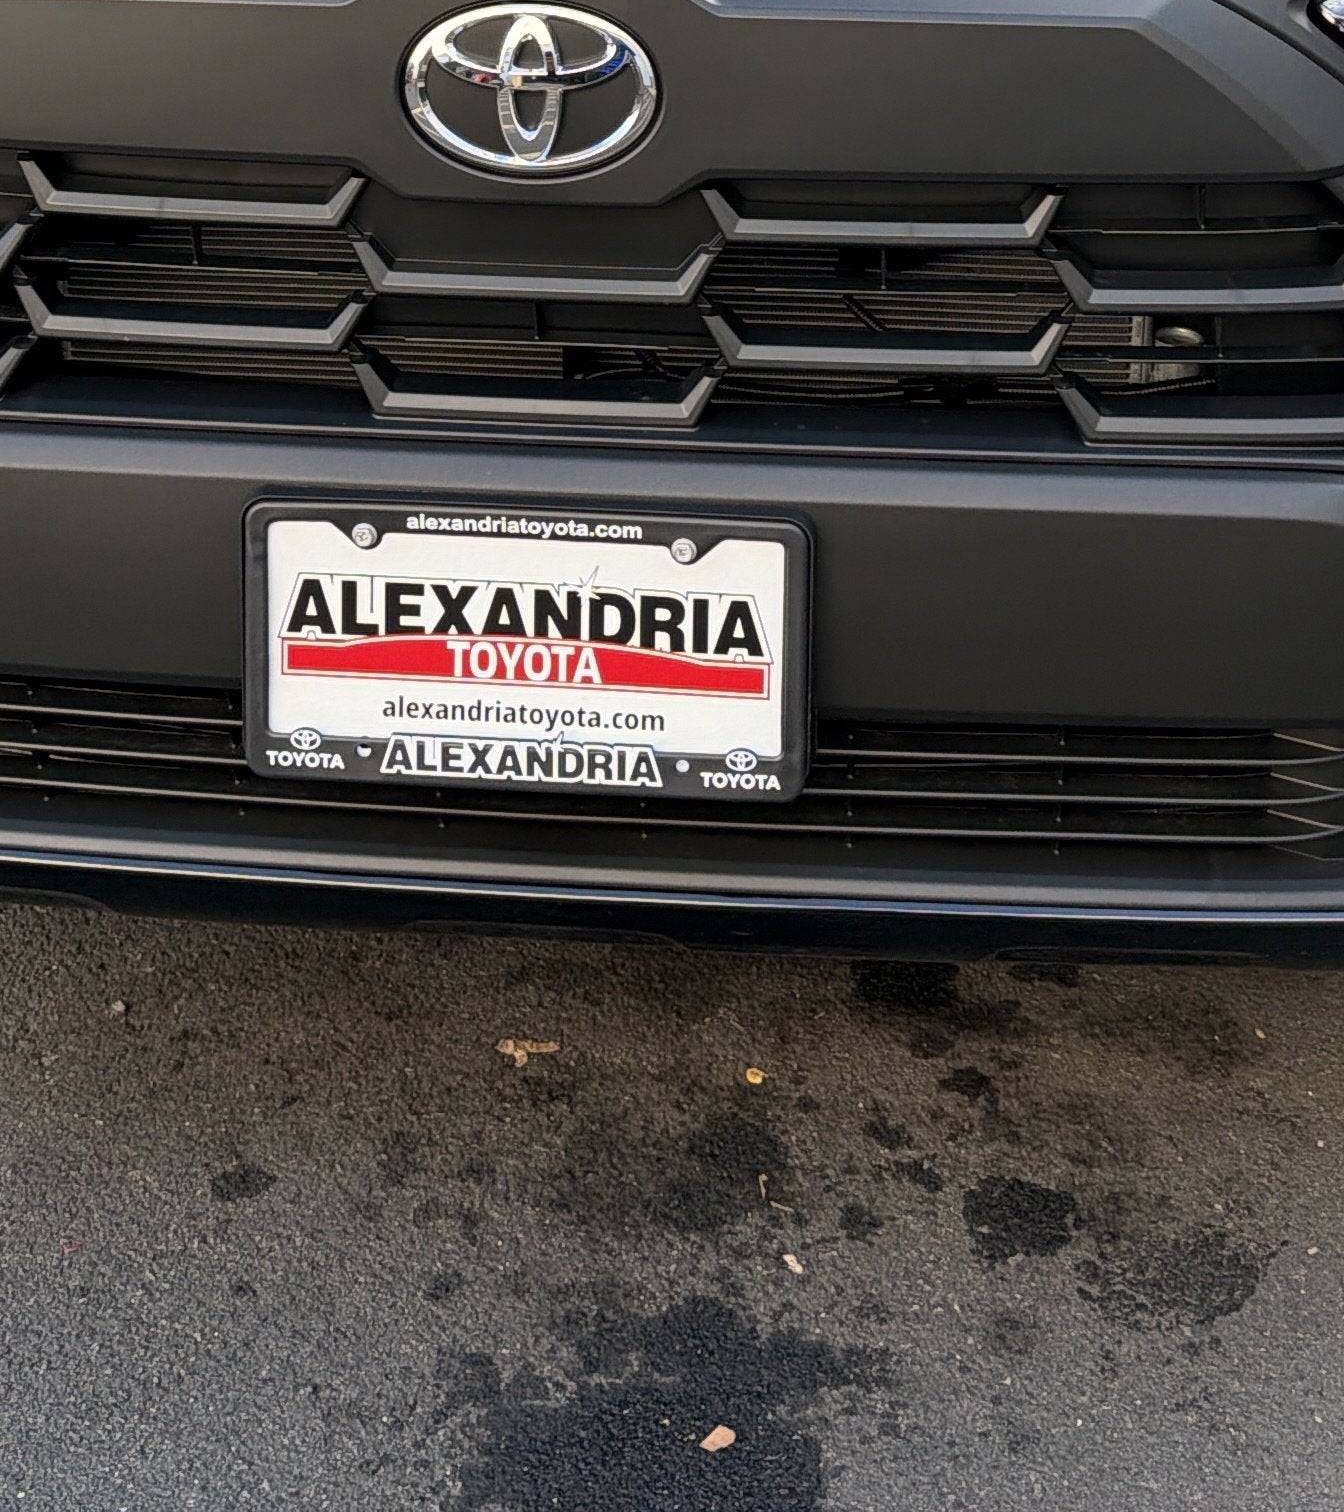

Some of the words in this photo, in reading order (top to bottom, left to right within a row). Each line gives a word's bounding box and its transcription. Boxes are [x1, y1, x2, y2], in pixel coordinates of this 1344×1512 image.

[406, 513, 643, 540] alexandriatoyota.com
[287, 578, 765, 657] ALEXANDRIA
[447, 642, 603, 684] TOYOTA
[382, 696, 666, 732] alexandriatoyota.com
[266, 750, 346, 771] TOYOTA
[380, 735, 663, 787] ALEXANDRIA
[701, 771, 782, 792] TOYOTA
